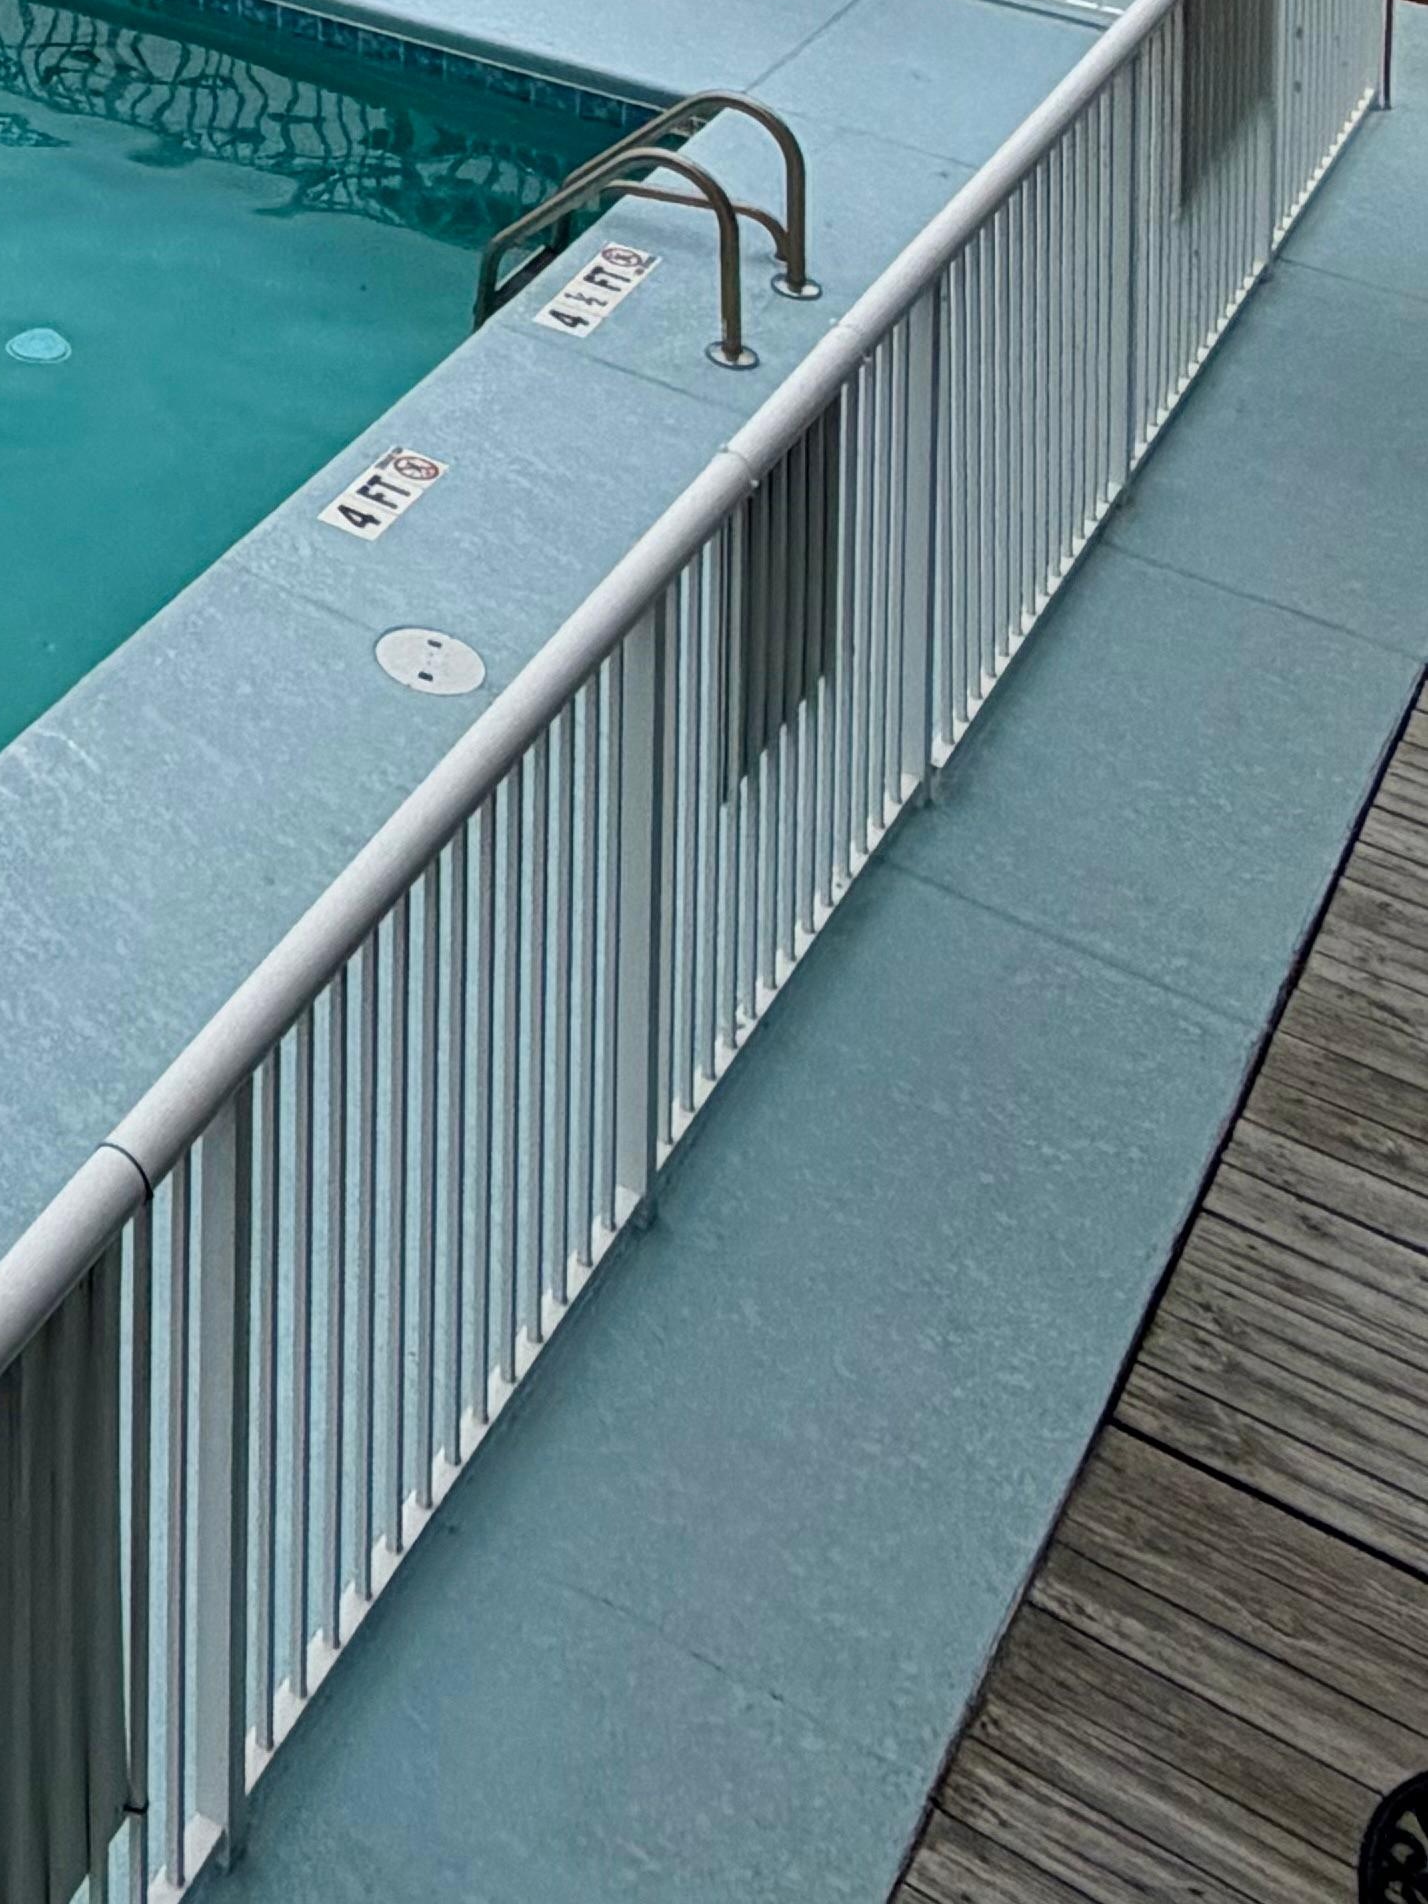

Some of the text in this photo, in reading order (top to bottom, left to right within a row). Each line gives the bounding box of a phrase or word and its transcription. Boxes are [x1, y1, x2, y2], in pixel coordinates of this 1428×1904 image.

[548, 309, 590, 328] 4
[583, 265, 632, 292] FT
[337, 473, 412, 529] 4 FT
